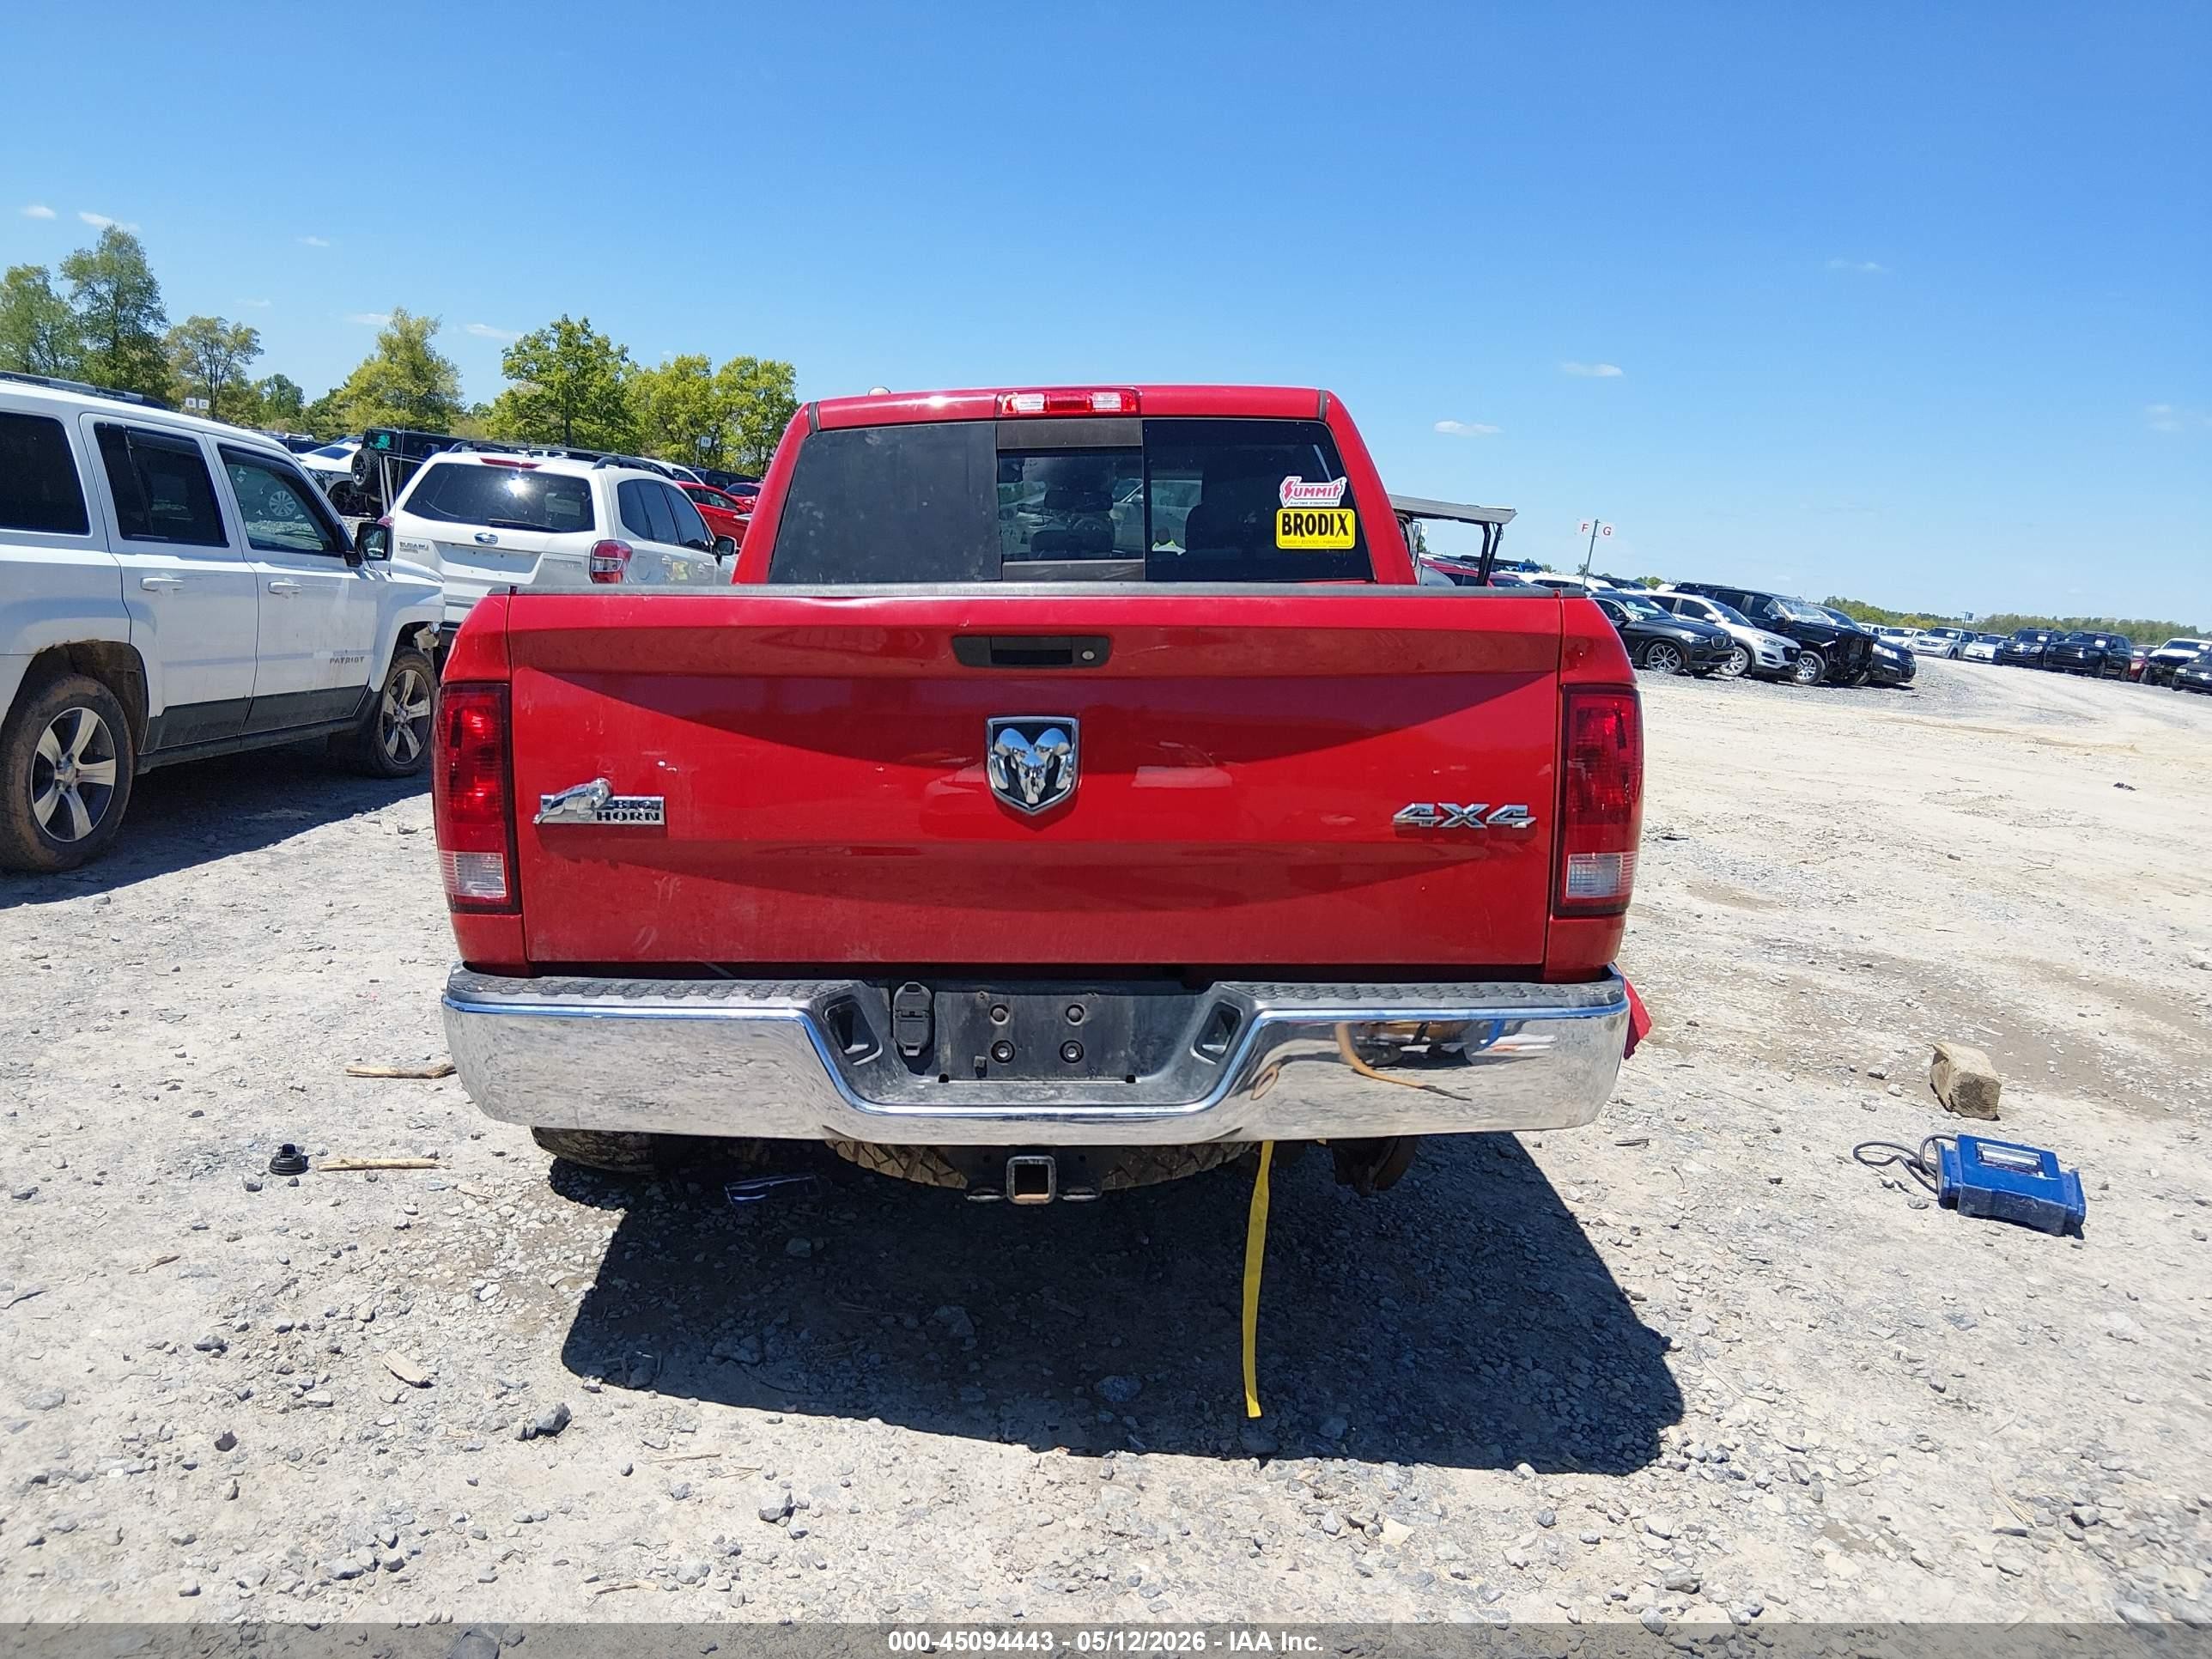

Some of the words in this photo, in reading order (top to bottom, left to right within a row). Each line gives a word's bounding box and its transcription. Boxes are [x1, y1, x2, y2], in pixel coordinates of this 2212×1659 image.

[1281, 513, 1349, 538] BRODIX
[1581, 523, 1589, 532] F
[1602, 526, 1612, 536] G
[330, 656, 365, 665] PATRIOT
[596, 811, 660, 821] HORN
[1393, 803, 1536, 829] 4X4
